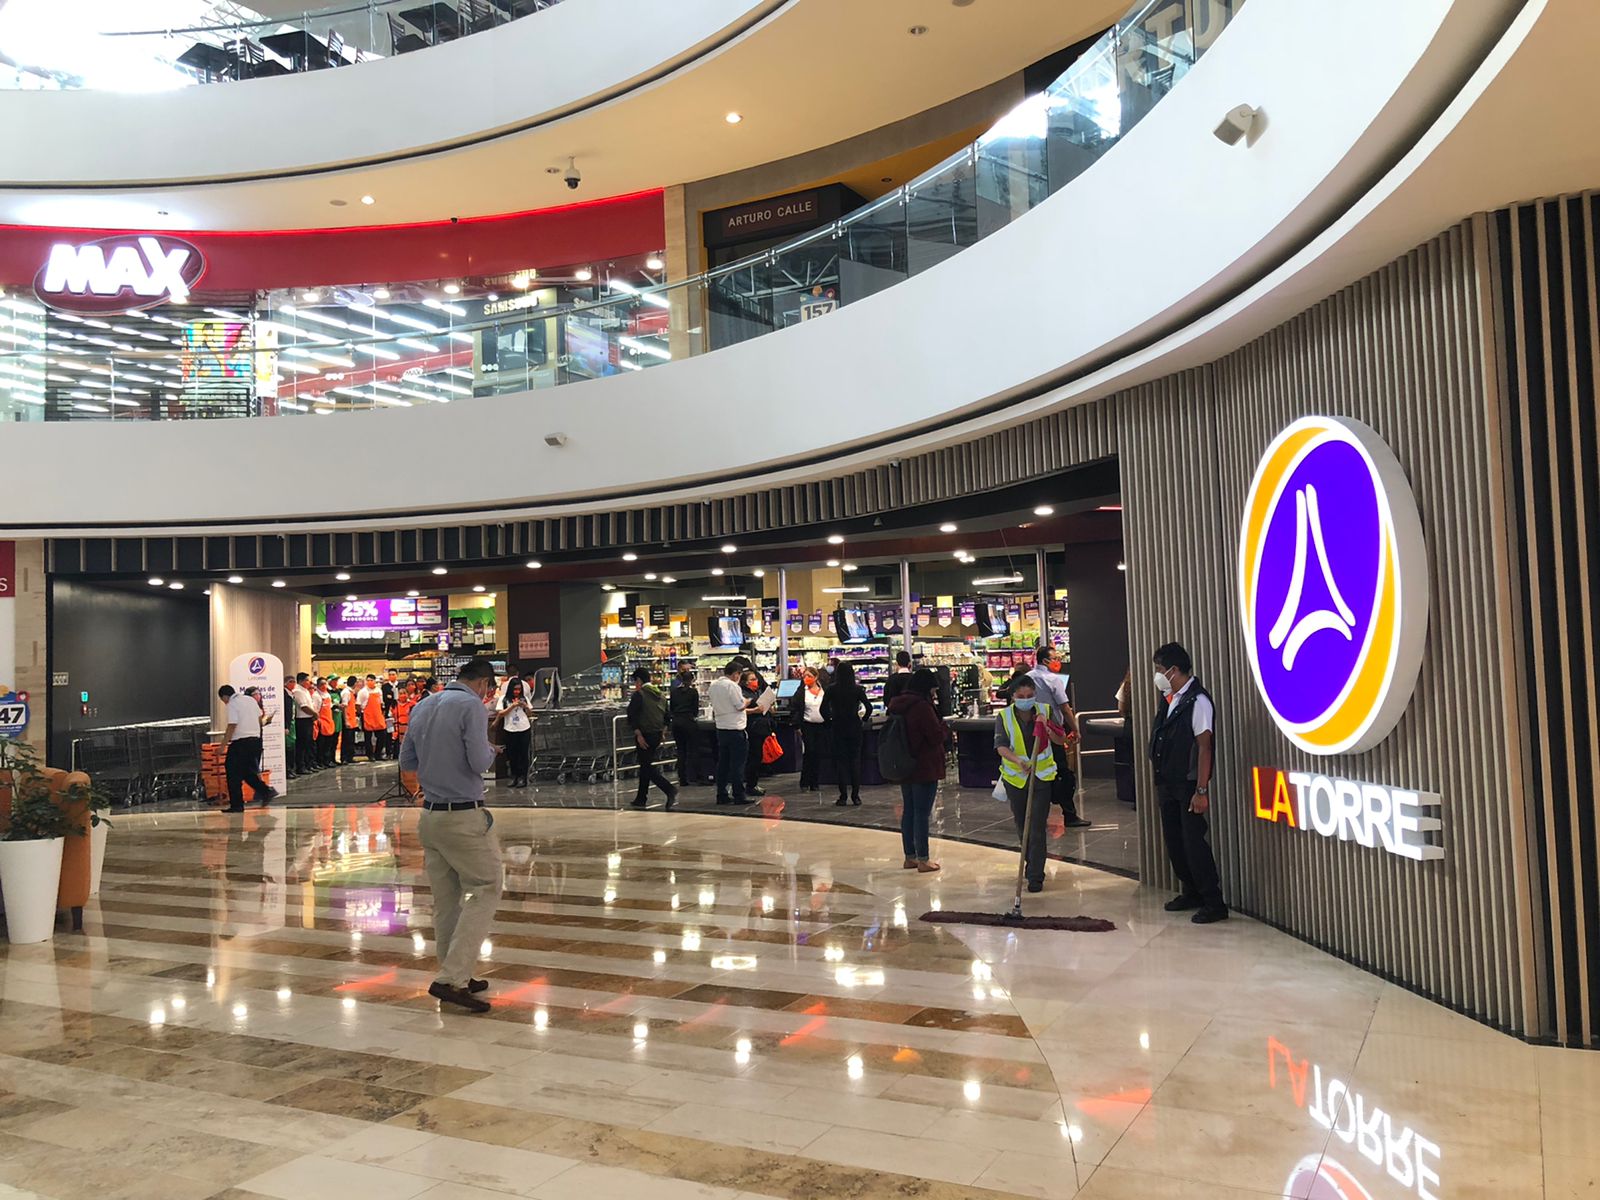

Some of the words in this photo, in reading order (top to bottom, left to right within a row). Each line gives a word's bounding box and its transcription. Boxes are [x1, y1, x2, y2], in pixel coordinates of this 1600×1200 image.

[727, 208, 773, 229] ARTURO
[776, 200, 813, 219] CALLE
[44, 237, 190, 301] MAX
[483, 294, 538, 316] SAMS
[803, 302, 834, 320] 157
[341, 600, 379, 617] 25%
[0, 707, 24, 724] 47
